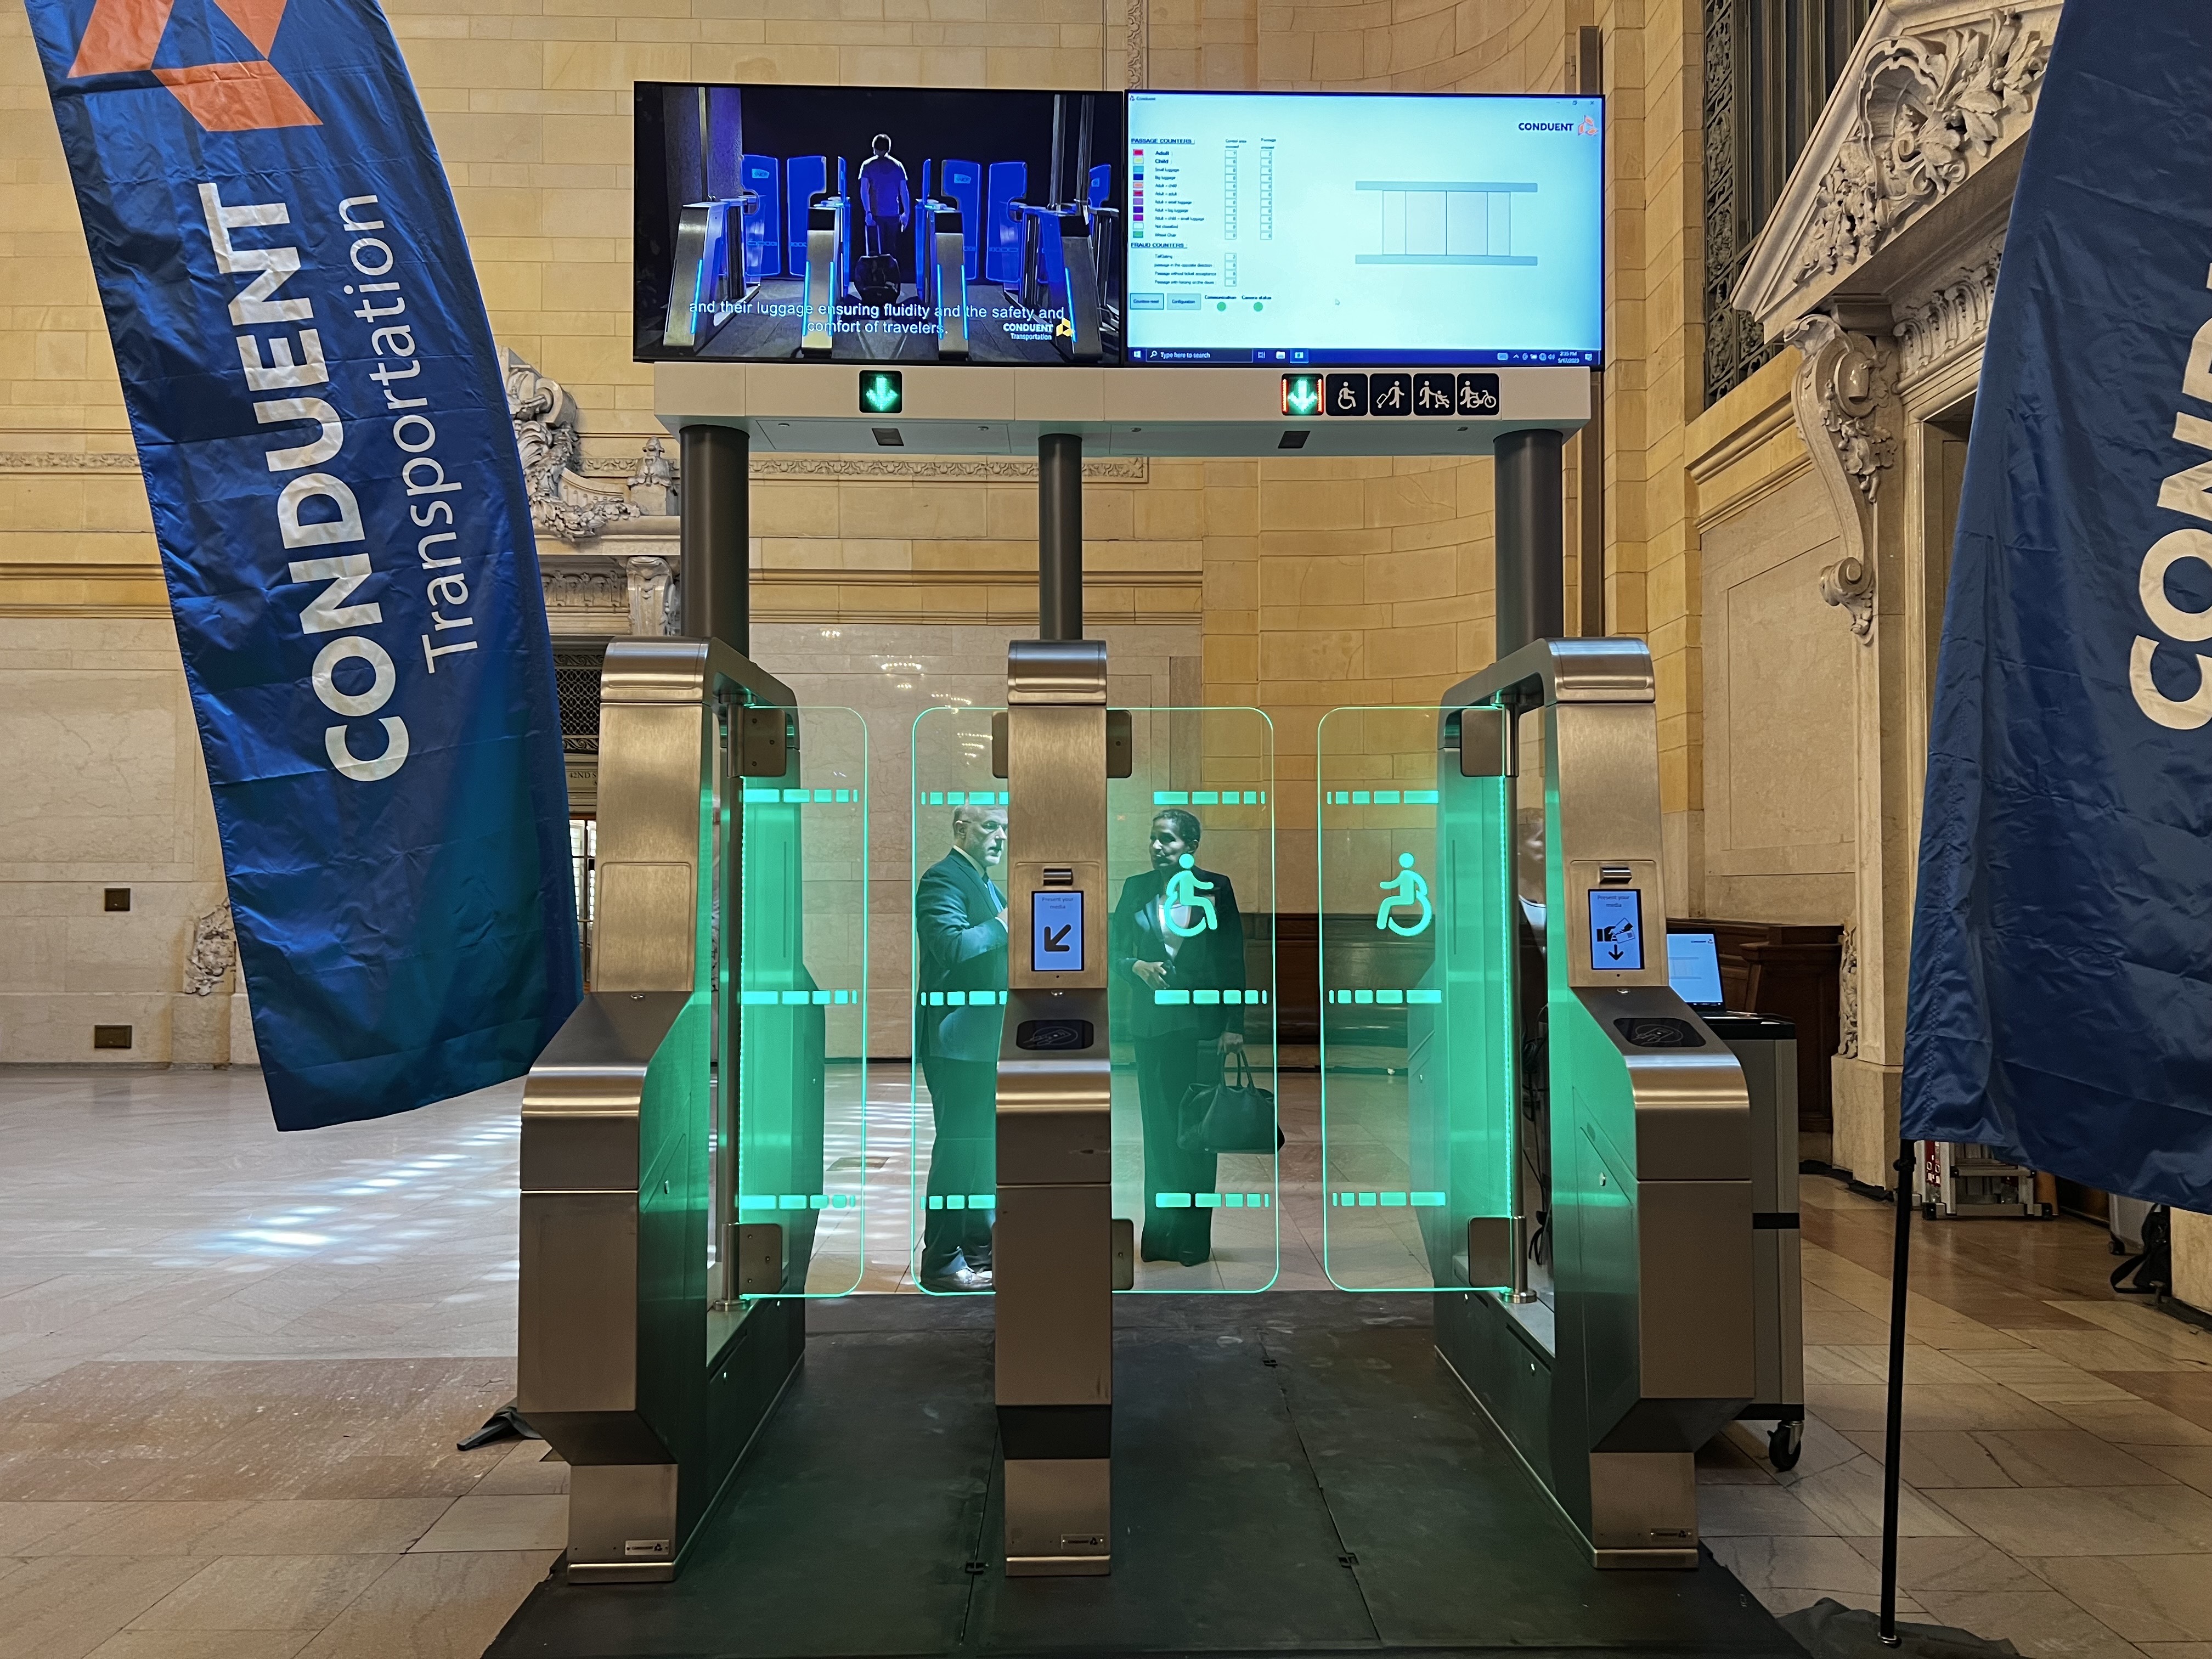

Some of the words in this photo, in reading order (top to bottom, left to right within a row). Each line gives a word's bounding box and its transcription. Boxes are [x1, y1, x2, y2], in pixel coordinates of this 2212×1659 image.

[1518, 122, 1574, 131] CONDUENT
[689, 300, 715, 313] and
[720, 301, 753, 313] their
[757, 301, 813, 317] luggage
[818, 303, 879, 318] ensuring
[883, 303, 930, 319] fluidity
[934, 304, 960, 317] and
[966, 304, 987, 318] the
[992, 305, 1034, 321] safety
[1039, 306, 1064, 319] and
[807, 320, 861, 333] comfort
[865, 320, 879, 333] of
[883, 321, 949, 334] travelers.
[1003, 323, 1054, 332] CONDUENT
[338, 194, 478, 674] Transportation
[198, 182, 409, 782] CONDUENT
